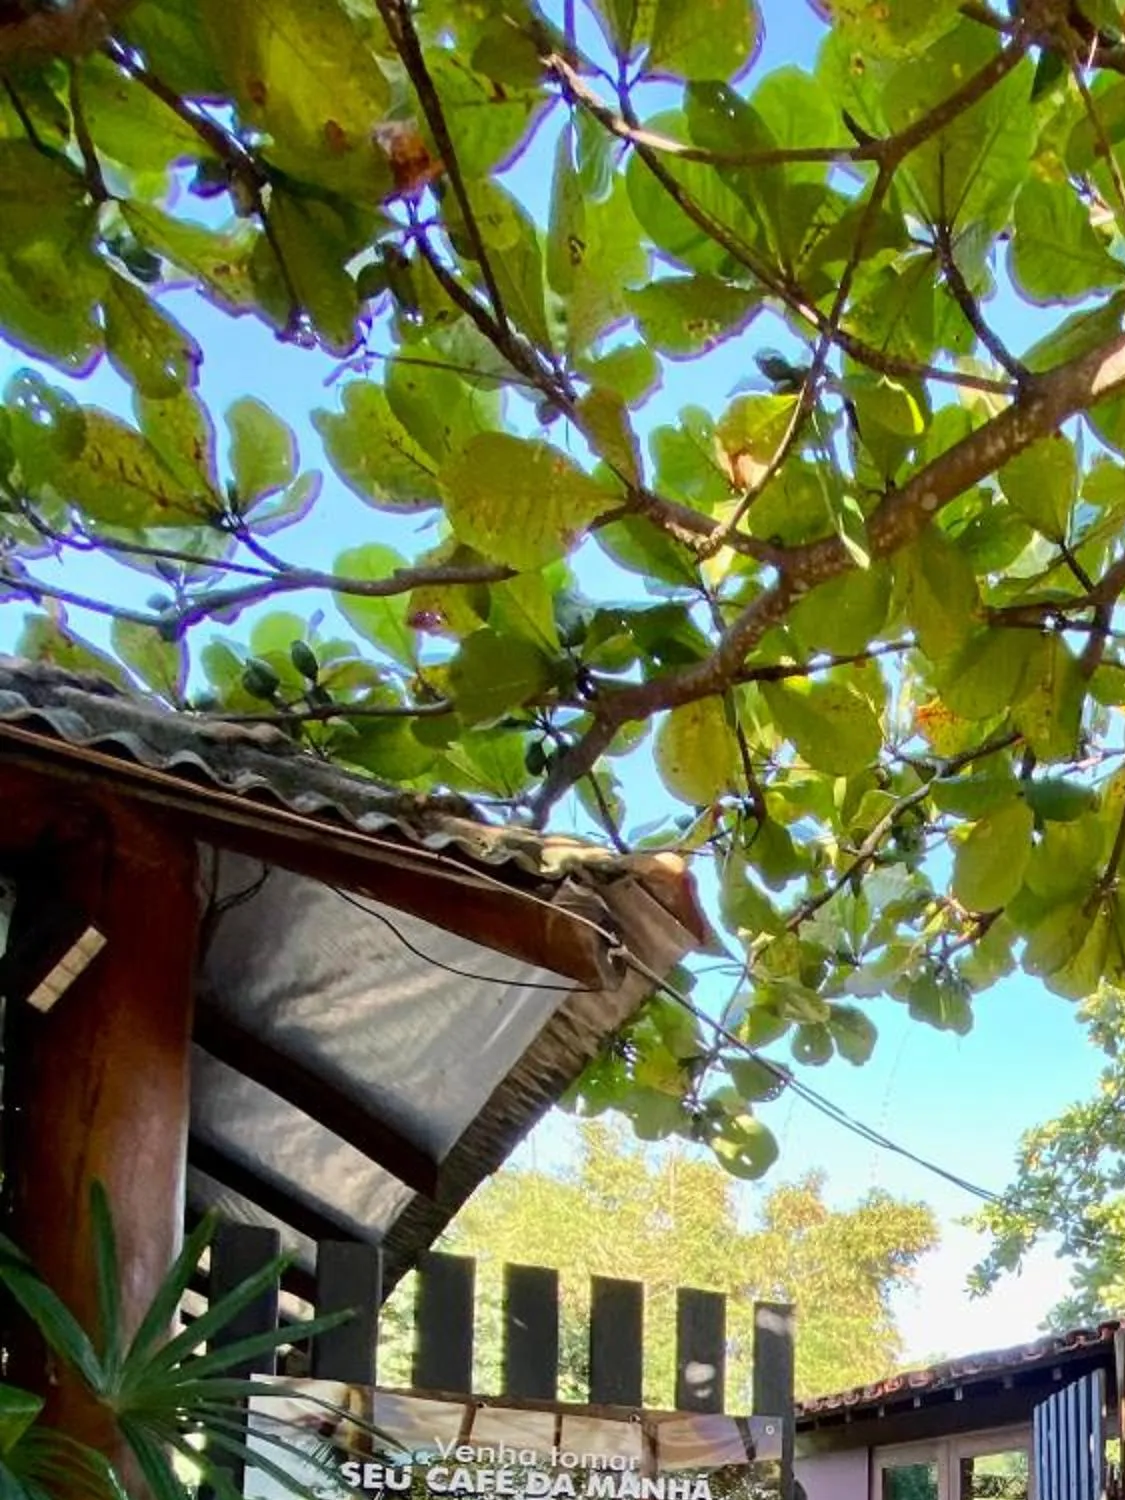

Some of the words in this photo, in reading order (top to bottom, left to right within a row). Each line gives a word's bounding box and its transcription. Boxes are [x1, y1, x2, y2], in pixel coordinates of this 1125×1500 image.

[434, 1436, 537, 1468] Venha
[550, 1445, 641, 1471] tomar
[340, 1461, 413, 1491] SEU
[426, 1463, 514, 1495] CAFÉ
[526, 1471, 577, 1498] DA
